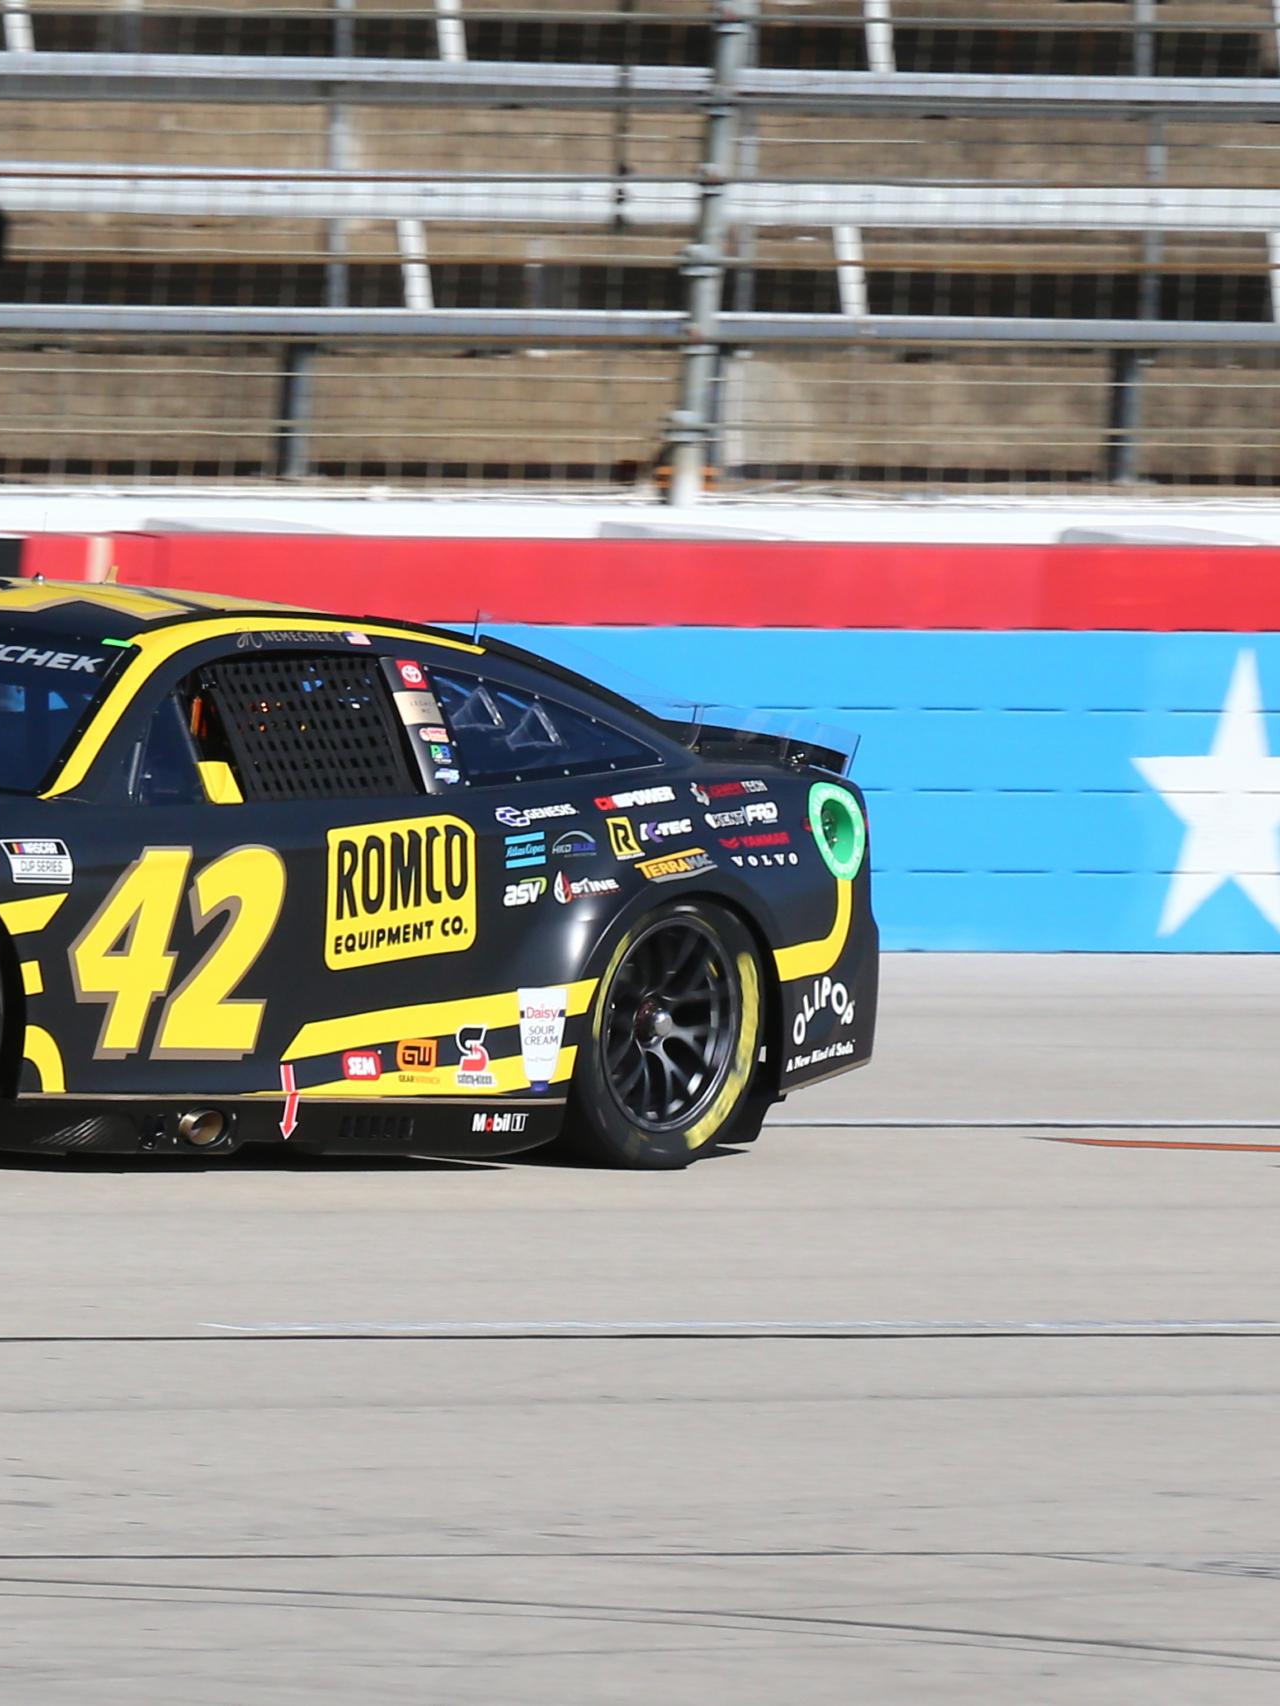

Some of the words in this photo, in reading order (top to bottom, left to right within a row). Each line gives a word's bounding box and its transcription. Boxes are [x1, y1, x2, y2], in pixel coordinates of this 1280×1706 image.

[523, 804, 577, 819] GENESIS
[640, 818, 692, 843] K-TEC
[740, 832, 790, 848] YANMAR
[505, 845, 525, 858] Atlas
[525, 843, 545, 856] Copco
[21, 860, 35, 871] CUP
[37, 860, 64, 872] SERIES
[731, 852, 799, 867] VOLVO
[336, 824, 468, 921] ROMCO
[570, 877, 620, 894] STINE
[334, 920, 434, 955] EQUIPMENT
[441, 916, 468, 937] CO.
[67, 844, 287, 1060] 42
[526, 1005, 558, 1021] Daisy
[528, 1026, 555, 1036] SOUR
[524, 1035, 559, 1045] CREAM
[347, 1056, 377, 1075] SEM
[785, 1058, 793, 1072] A
[794, 1055, 811, 1069] New
[472, 1112, 511, 1133] Mobil
